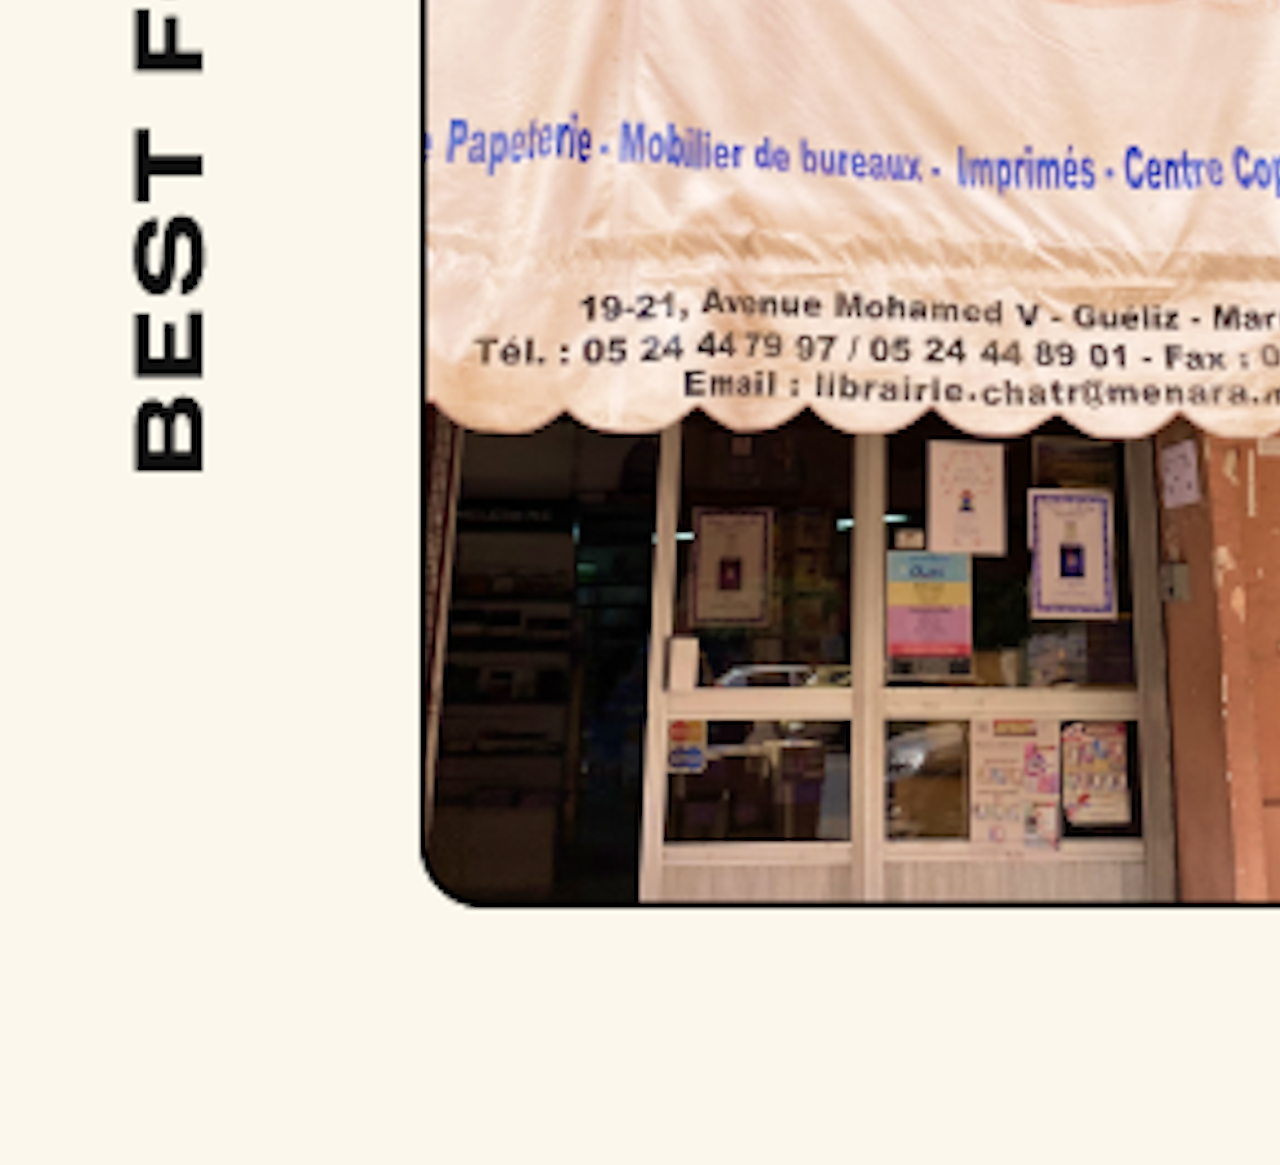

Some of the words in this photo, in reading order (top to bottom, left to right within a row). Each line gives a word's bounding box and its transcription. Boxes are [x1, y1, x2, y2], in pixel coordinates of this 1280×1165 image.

[445, 112, 594, 176] Papeterie
[618, 120, 745, 171] Mobilier
[755, 136, 791, 173] de
[801, 139, 924, 182] bureaux
[957, 143, 1096, 197] Imprimés
[1124, 144, 1224, 190] Centre
[700, 287, 823, 320] Avenue
[833, 291, 1002, 325] Mohamed
[1015, 302, 1040, 327] V
[582, 337, 628, 365] 05
[640, 335, 683, 363] 24
[698, 332, 737, 359] 44
[740, 332, 783, 359] 79
[797, 335, 838, 363] 97
[923, 337, 967, 365] 24
[980, 340, 1024, 365] 44
[1035, 341, 1076, 367] 89
[1089, 343, 1128, 369] 01
[1164, 344, 1225, 371] Fax
[683, 371, 777, 397] Email
